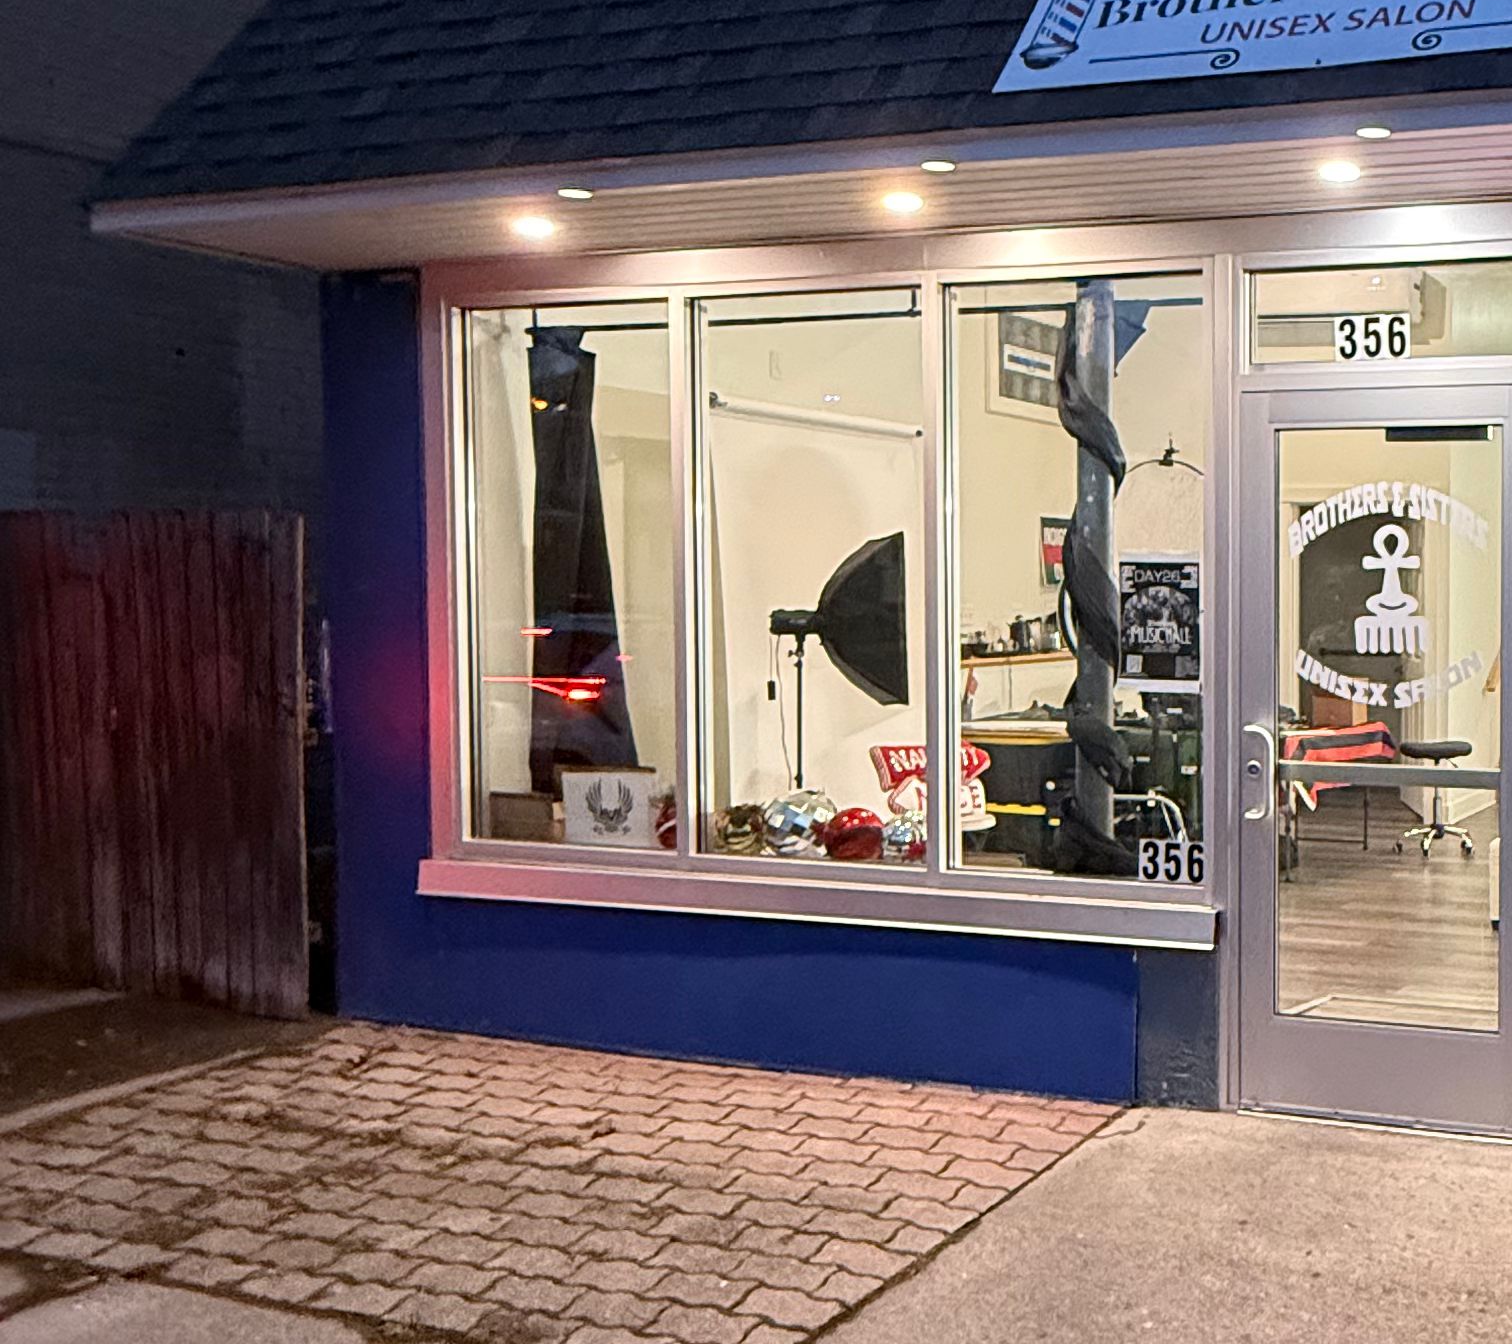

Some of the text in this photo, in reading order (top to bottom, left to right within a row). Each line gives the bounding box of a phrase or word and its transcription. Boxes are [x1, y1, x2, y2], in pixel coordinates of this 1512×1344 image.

[1200, 11, 1335, 44] UNISEX
[1339, 317, 1406, 359] 356
[1288, 481, 1389, 560] BROTHERS
[1392, 481, 1405, 518] &
[1296, 649, 1484, 708] UNISEX SAON
[1143, 842, 1203, 883] 356
